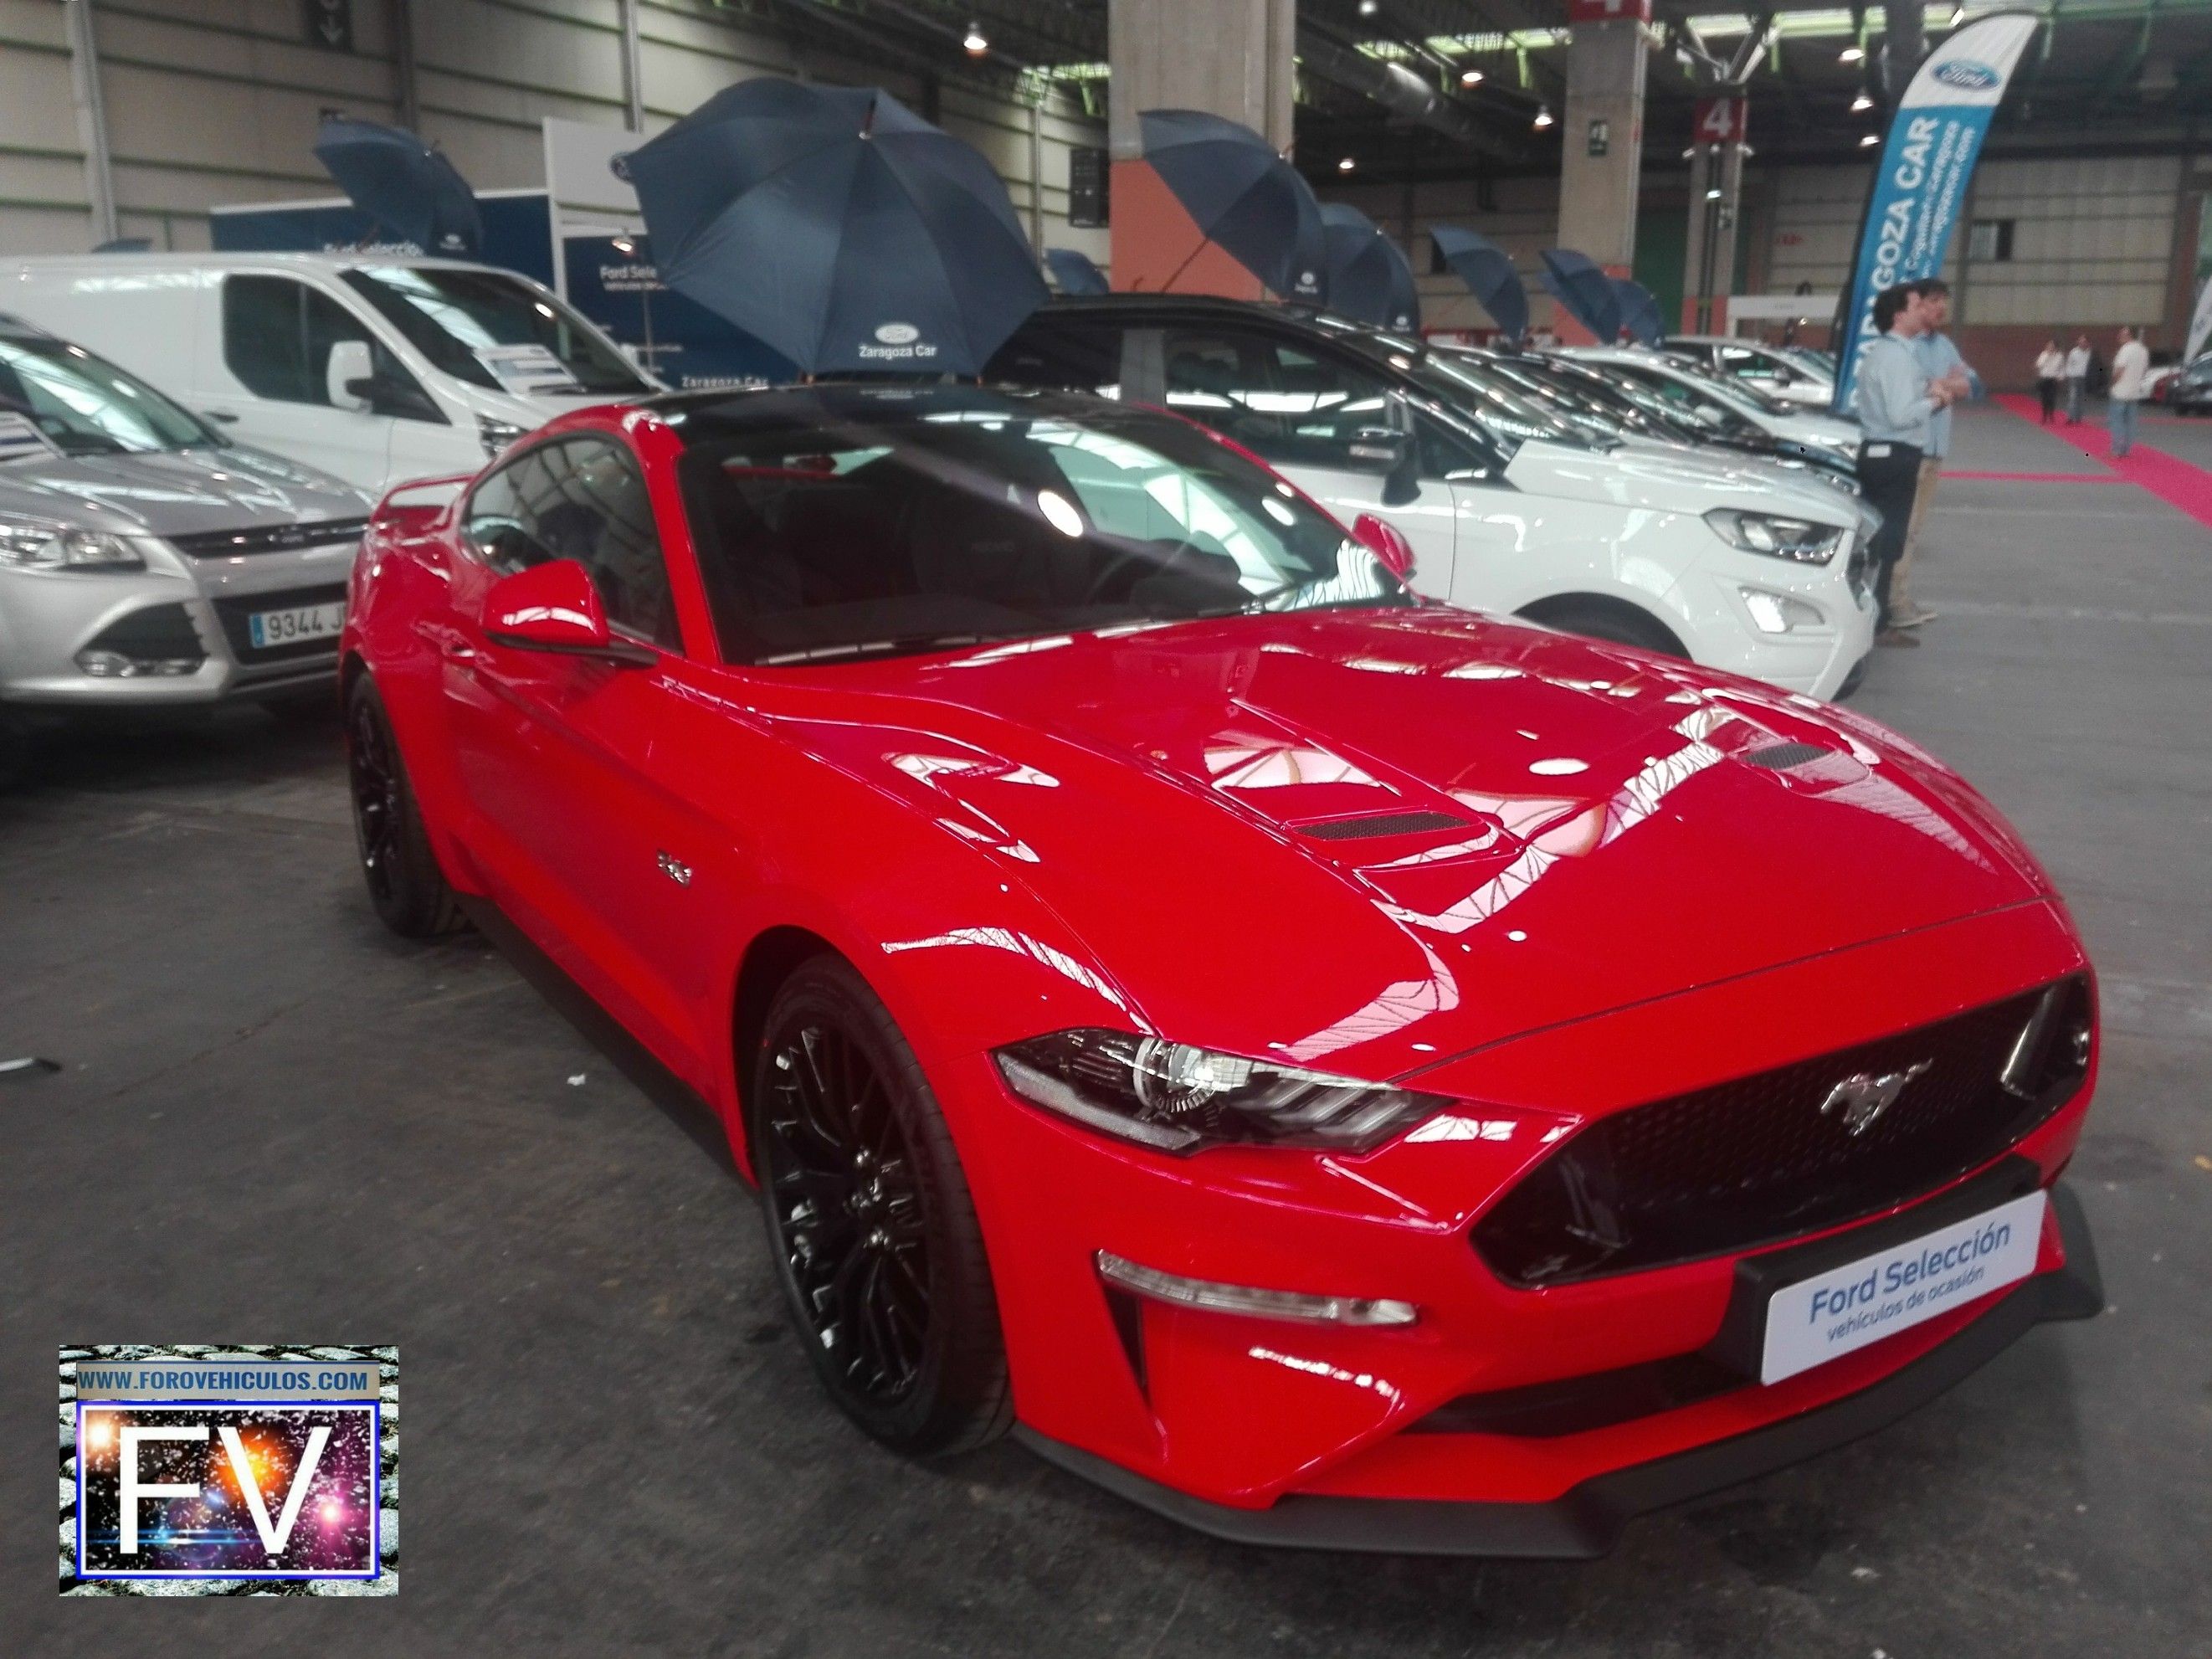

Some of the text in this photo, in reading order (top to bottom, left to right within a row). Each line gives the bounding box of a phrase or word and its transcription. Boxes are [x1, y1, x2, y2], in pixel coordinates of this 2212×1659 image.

[1702, 99, 1732, 137] 4
[1894, 116, 1941, 190] CAR
[859, 345, 937, 361] Zaragoza Car
[269, 609, 323, 639] 9344
[1809, 1221, 2010, 1323] Ford Selección
[1907, 1290, 1925, 1310] de
[1927, 1266, 1984, 1301] ocasión
